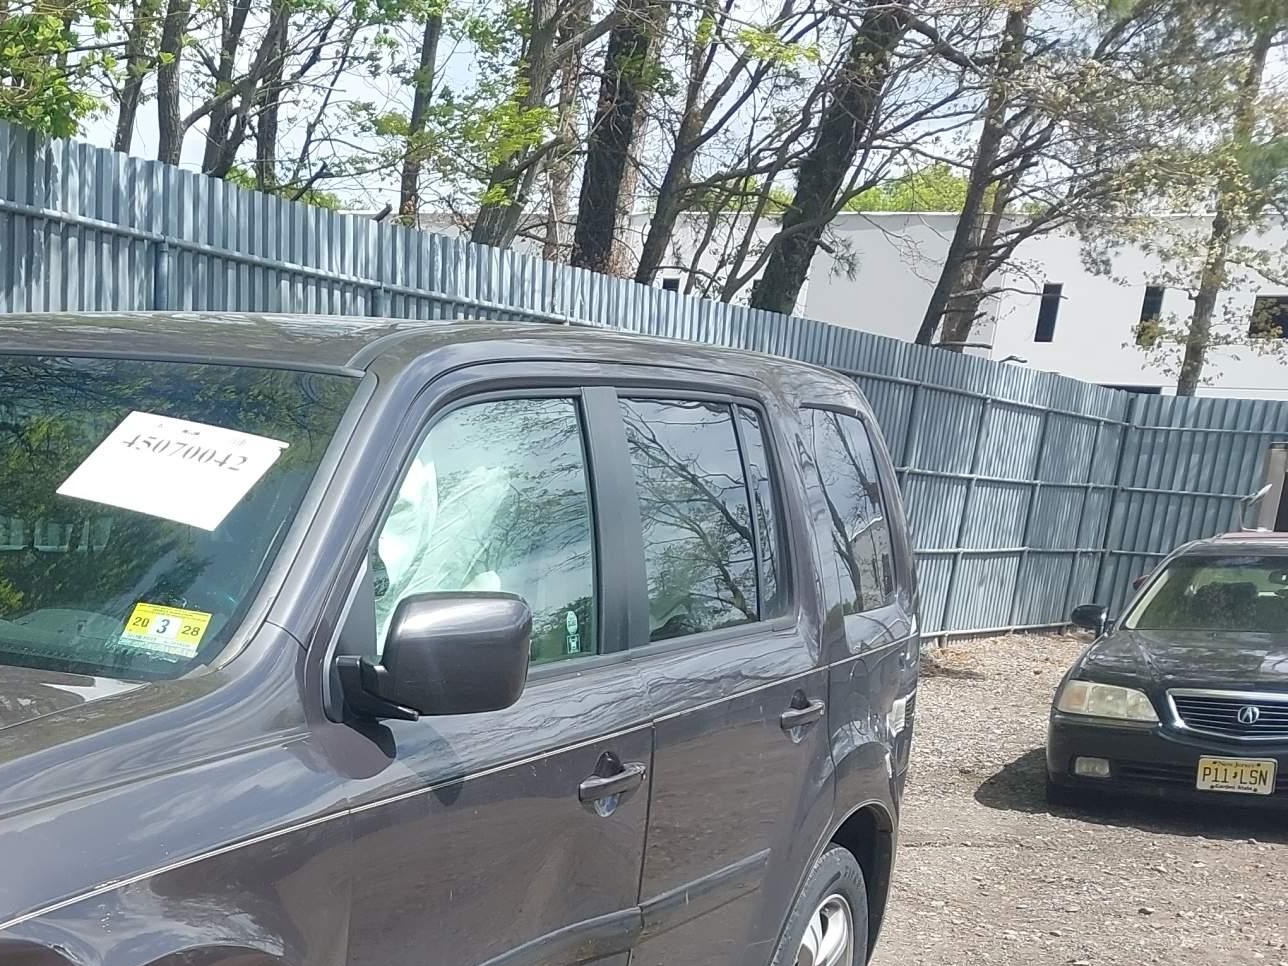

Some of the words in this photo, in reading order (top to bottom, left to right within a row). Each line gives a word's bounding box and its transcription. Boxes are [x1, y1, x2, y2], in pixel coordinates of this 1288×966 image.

[122, 434, 249, 471] 45070042
[132, 616, 150, 628] 20
[156, 618, 171, 634] 3
[181, 625, 201, 637] 28
